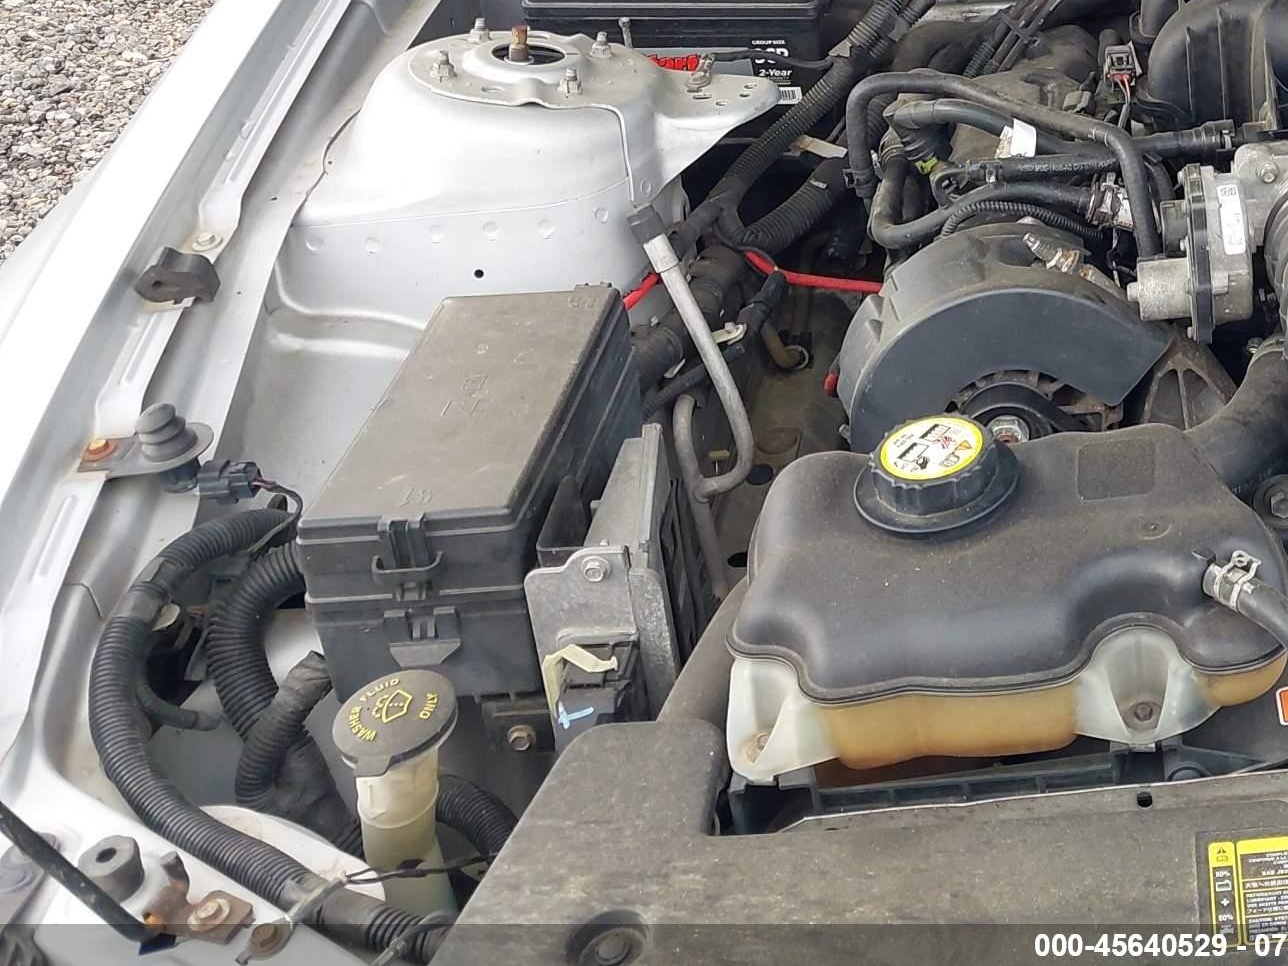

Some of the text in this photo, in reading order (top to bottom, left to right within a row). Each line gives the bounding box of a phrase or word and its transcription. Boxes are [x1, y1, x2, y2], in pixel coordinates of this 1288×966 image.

[759, 69, 792, 77] 2-Year
[349, 677, 438, 741] WASHER FLUID ONLY
